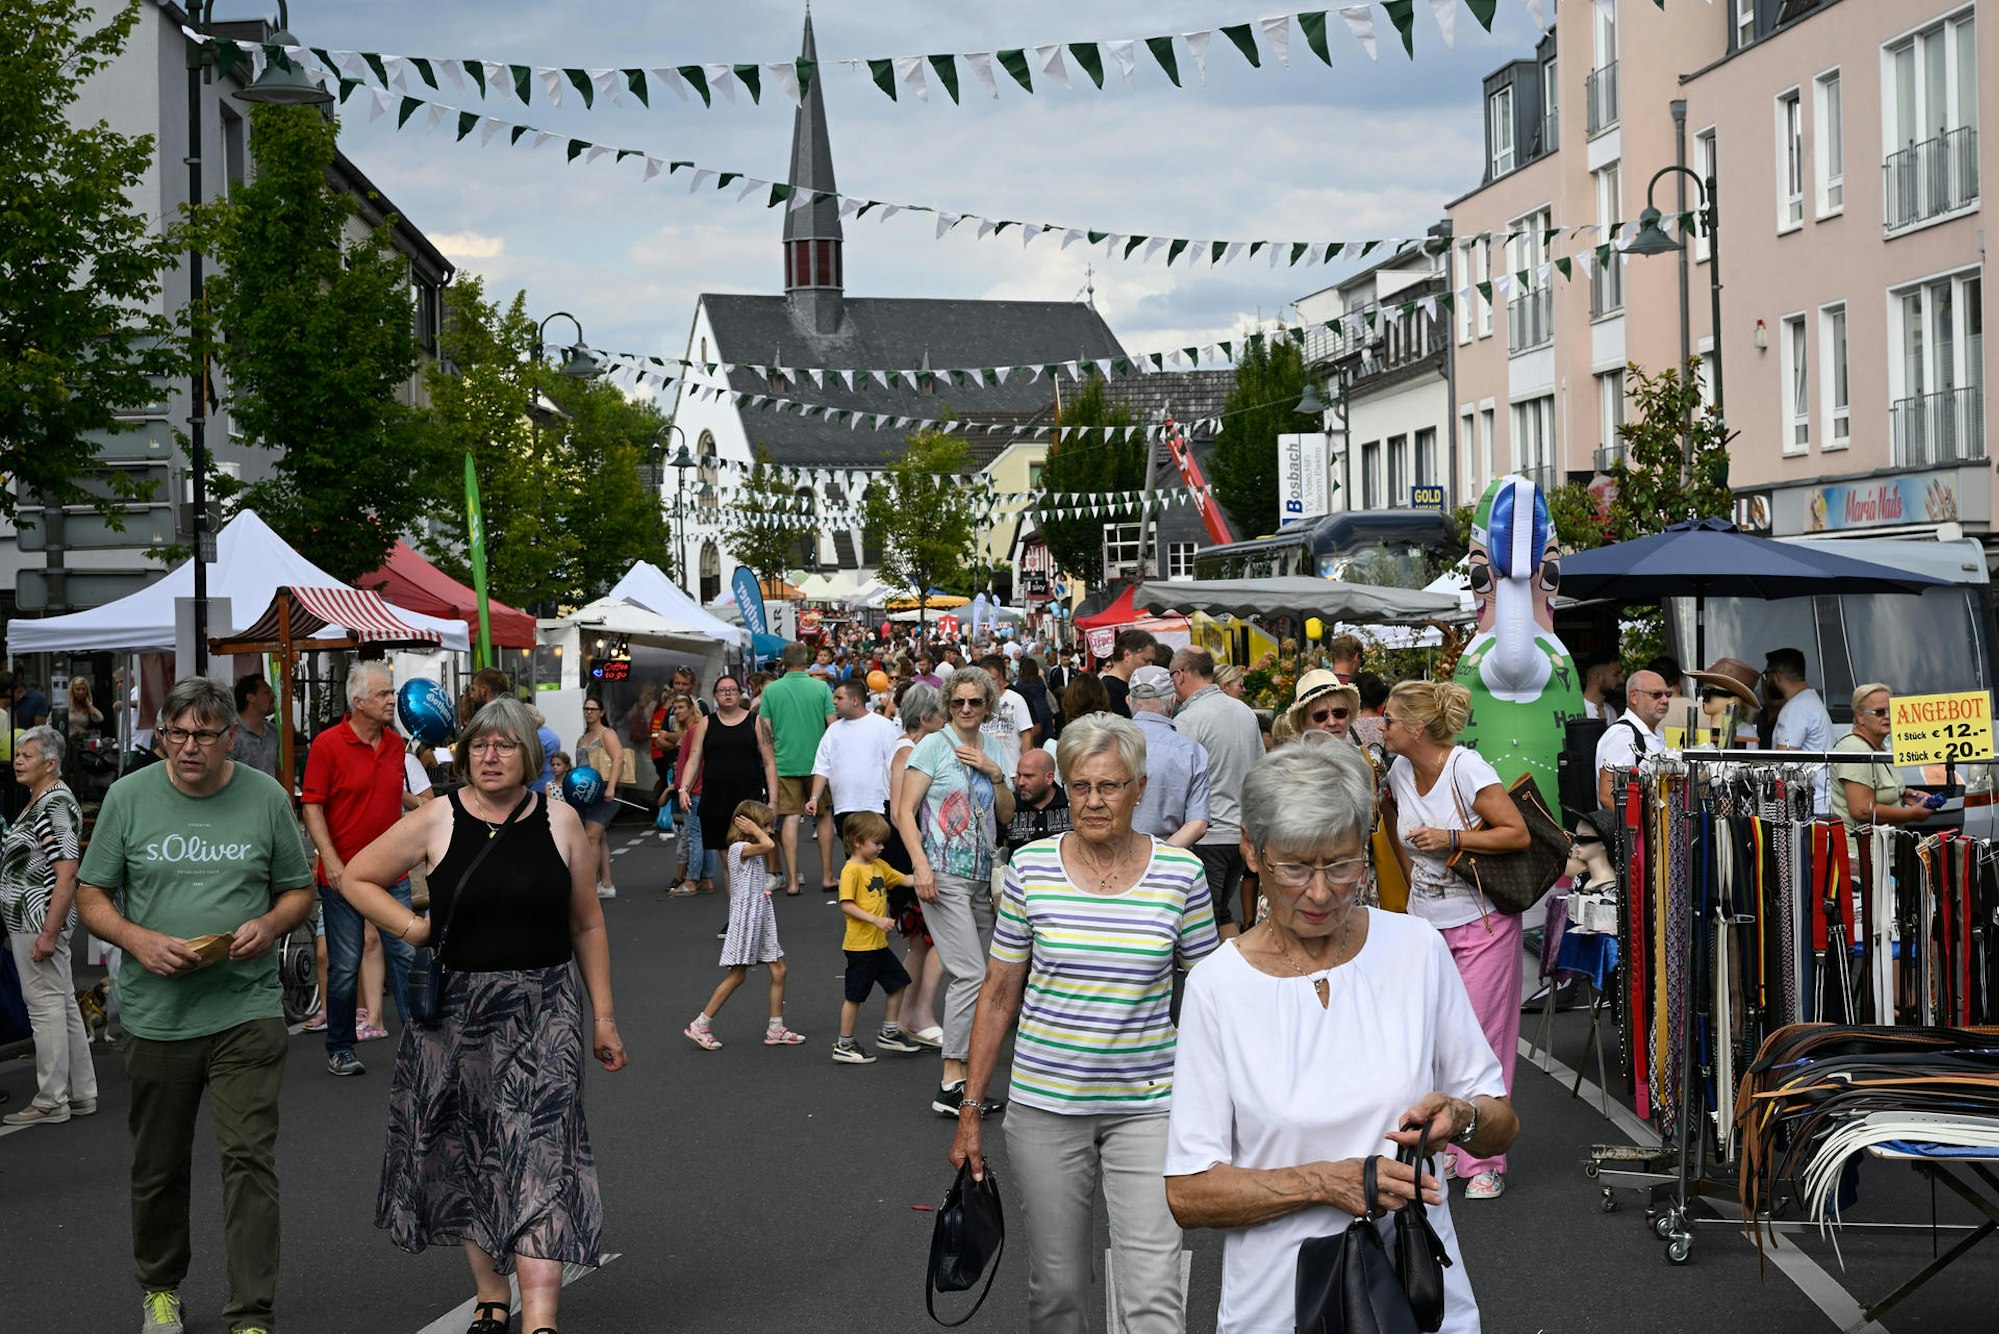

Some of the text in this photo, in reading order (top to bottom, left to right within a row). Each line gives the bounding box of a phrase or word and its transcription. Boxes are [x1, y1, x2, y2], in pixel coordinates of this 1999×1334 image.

[1286, 443, 1303, 514] Bosbach
[1414, 489, 1442, 503] GOLD
[1844, 485, 1903, 523] Maria Nails
[1031, 584, 1047, 592] sky
[604, 662, 629, 671] Coffee
[614, 672, 627, 680] go
[1897, 698, 1983, 724] ANGEBOT
[1897, 733, 1902, 741] 1
[1904, 731, 1927, 741] Stück
[1943, 723, 1987, 738] 12.-
[1899, 741, 1988, 762] 2 Stück € 20.-
[146, 834, 251, 862] s.Oliver
